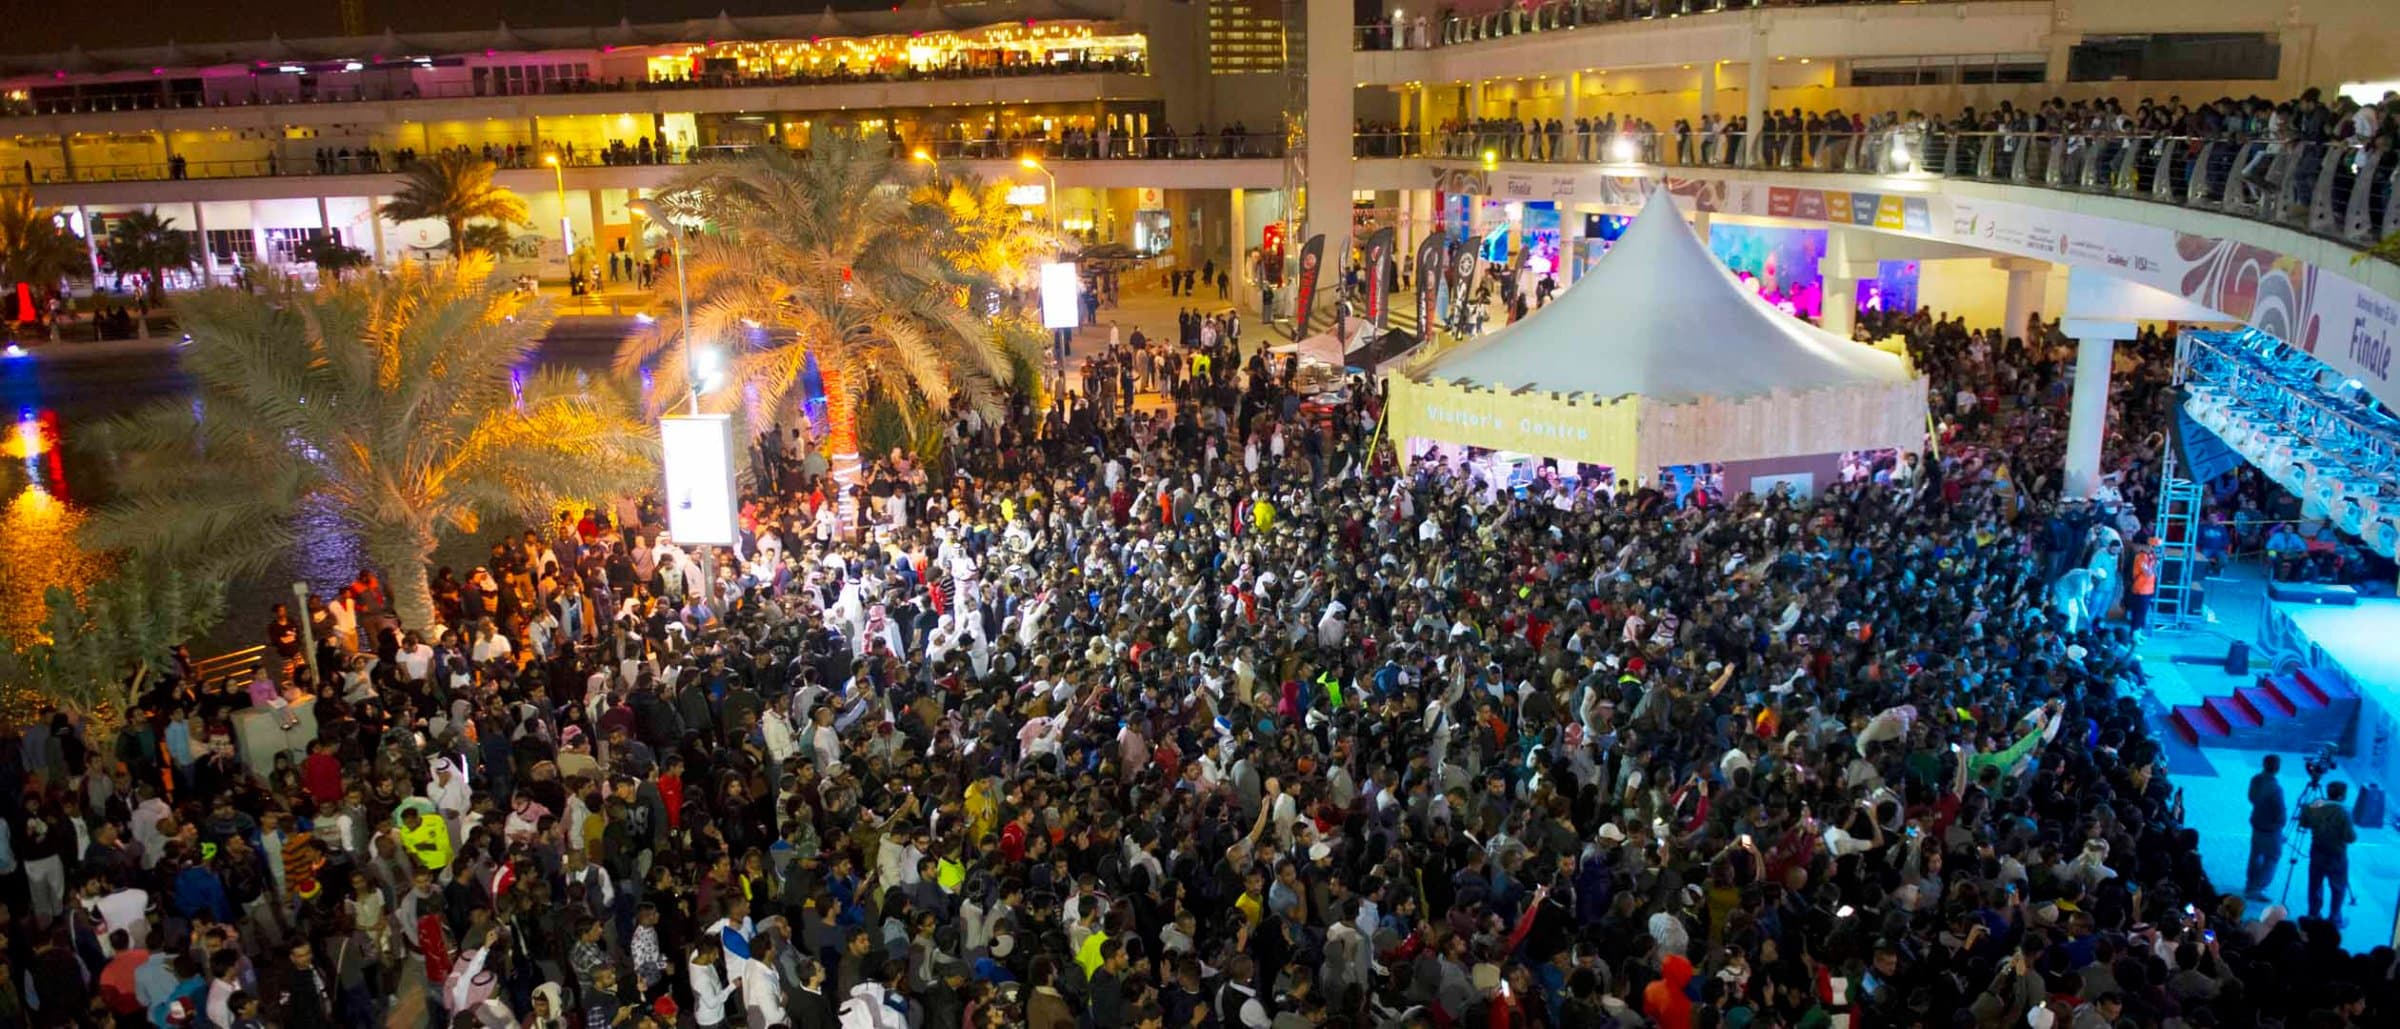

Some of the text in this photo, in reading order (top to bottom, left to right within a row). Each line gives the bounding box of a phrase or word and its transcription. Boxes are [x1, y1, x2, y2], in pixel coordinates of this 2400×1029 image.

[2348, 316, 2392, 381] Finale
[1427, 404, 1589, 441] Visitor's Centre
